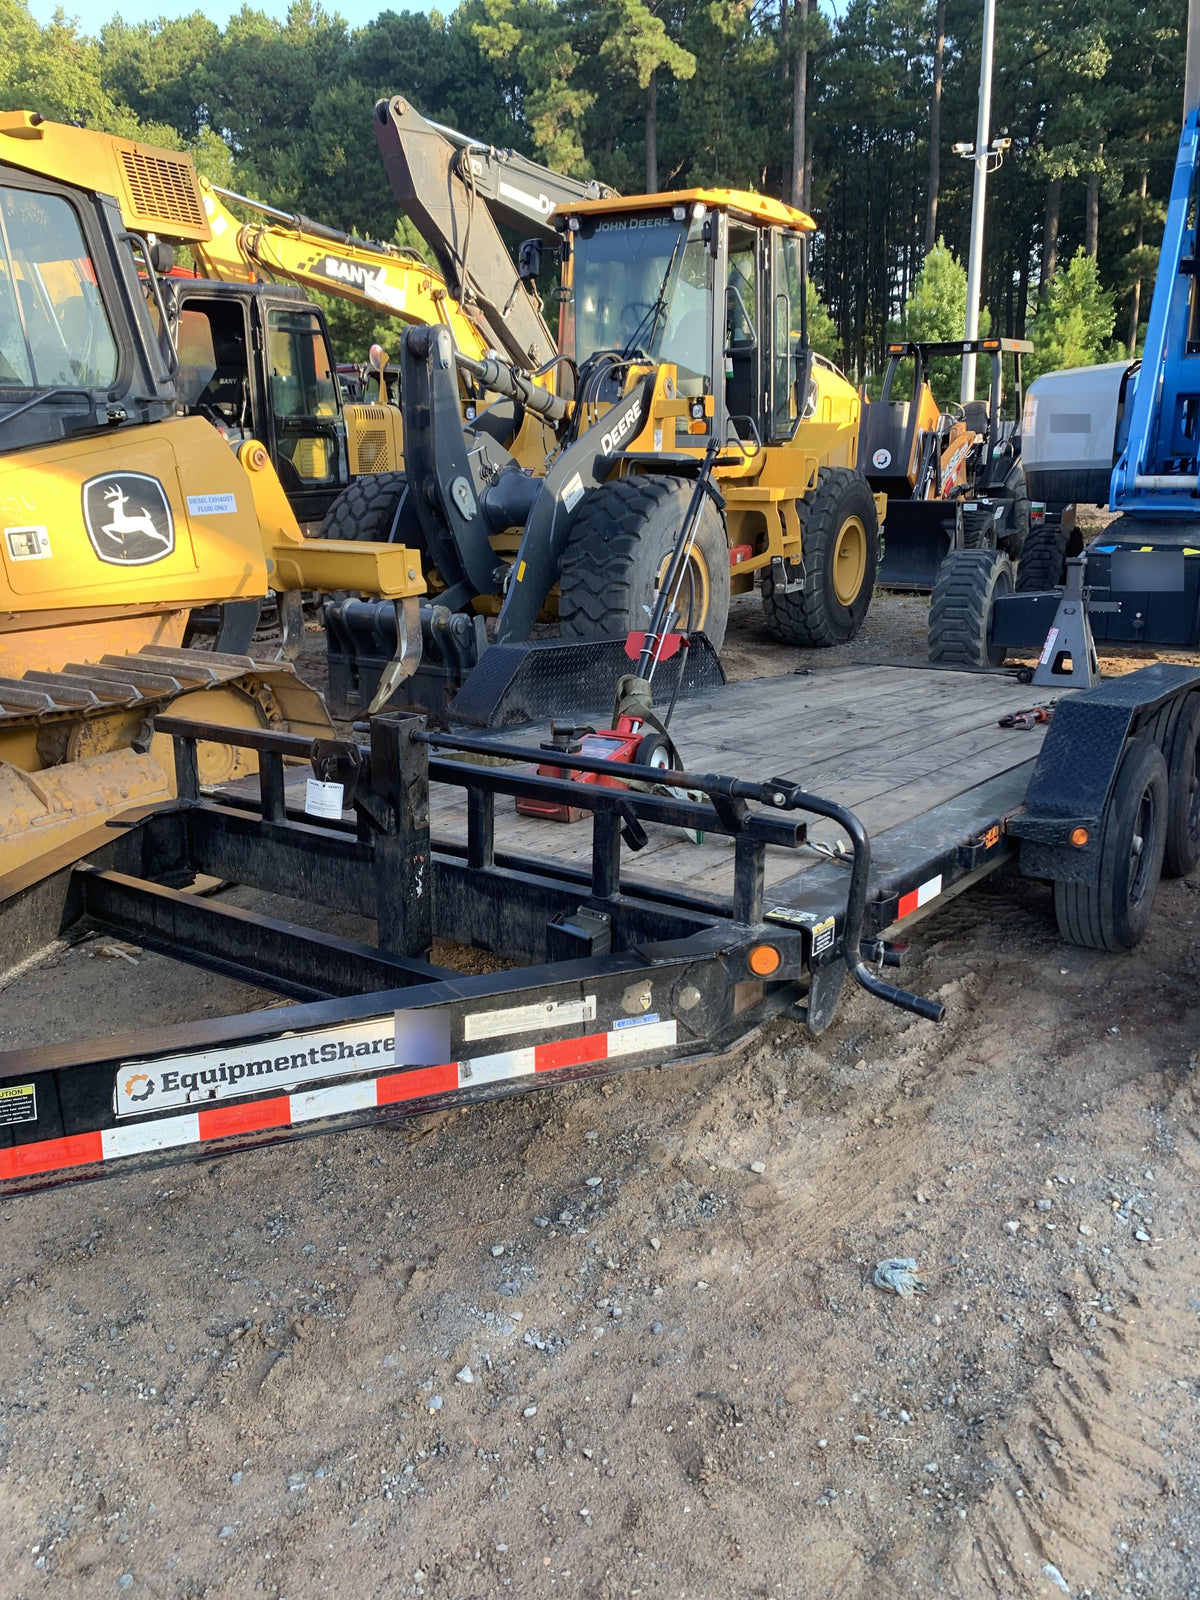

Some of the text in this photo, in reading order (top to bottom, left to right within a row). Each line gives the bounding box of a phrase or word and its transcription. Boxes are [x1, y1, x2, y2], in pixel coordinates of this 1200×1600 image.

[594, 217, 670, 233] JOHN DEERE
[325, 257, 375, 285] SANY
[600, 398, 643, 457] DEERE
[188, 494, 233, 505] DIESEL EXHAUST
[197, 503, 228, 513] FLUID ONLY
[160, 1036, 395, 1093] EquipmentShare
[0, 1089, 23, 1097] UTION
